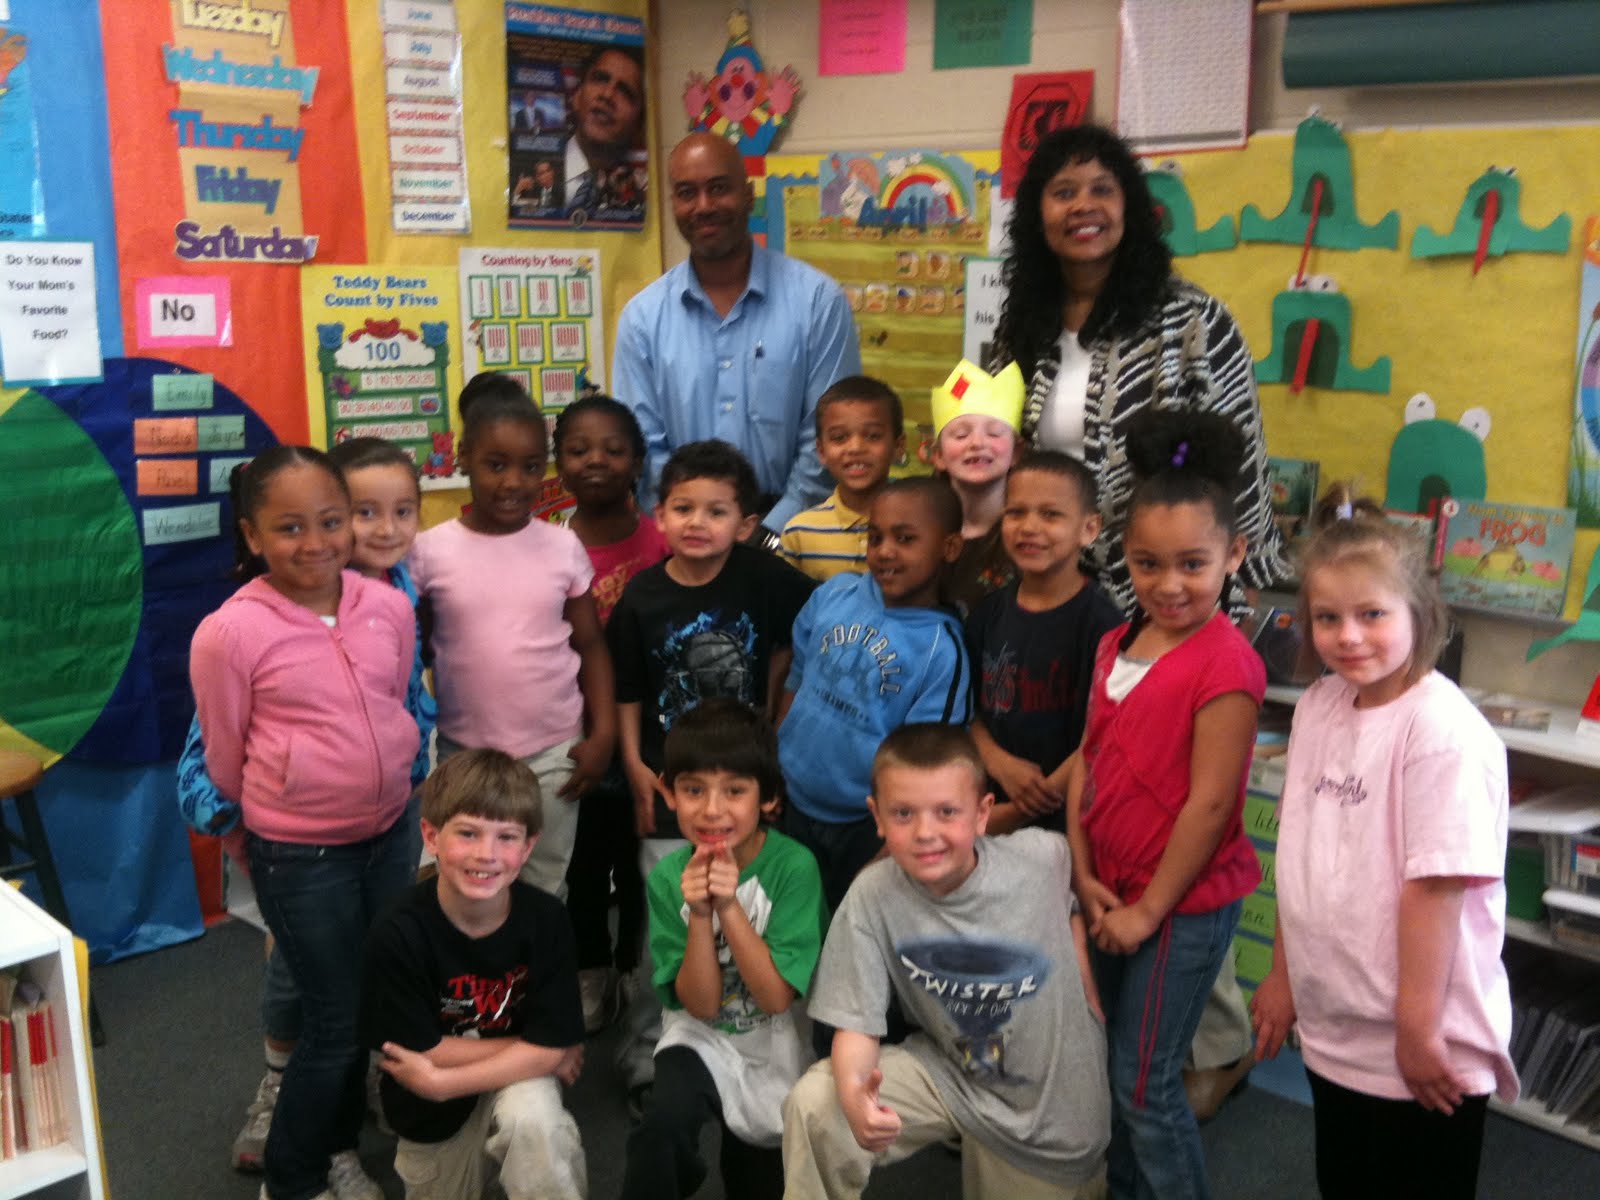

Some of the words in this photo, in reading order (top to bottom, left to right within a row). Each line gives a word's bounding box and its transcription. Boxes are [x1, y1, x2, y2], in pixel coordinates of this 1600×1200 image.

[404, 75, 440, 88] August
[393, 108, 451, 122] September
[195, 165, 281, 214] Friday
[400, 178, 454, 189] November
[402, 209, 456, 222] December
[6, 254, 22, 265] Do
[26, 254, 49, 265] You
[52, 254, 83, 266] Know
[482, 255, 530, 268] Counting
[531, 255, 548, 268] by
[549, 255, 573, 266] Tens
[8, 279, 35, 291] Your
[38, 280, 75, 291] Mom's
[333, 275, 381, 290] Teddy
[385, 275, 427, 288] Bears
[325, 293, 372, 306] Count
[377, 294, 395, 309] by
[399, 293, 439, 306] Fives
[22, 304, 68, 315] Favorite
[161, 299, 195, 322] No
[33, 329, 68, 341] Food?
[364, 341, 401, 361] 100
[1479, 517, 1546, 547] FROG
[820, 622, 902, 697] FOOTBALL
[901, 954, 1037, 1001] TWISTER
